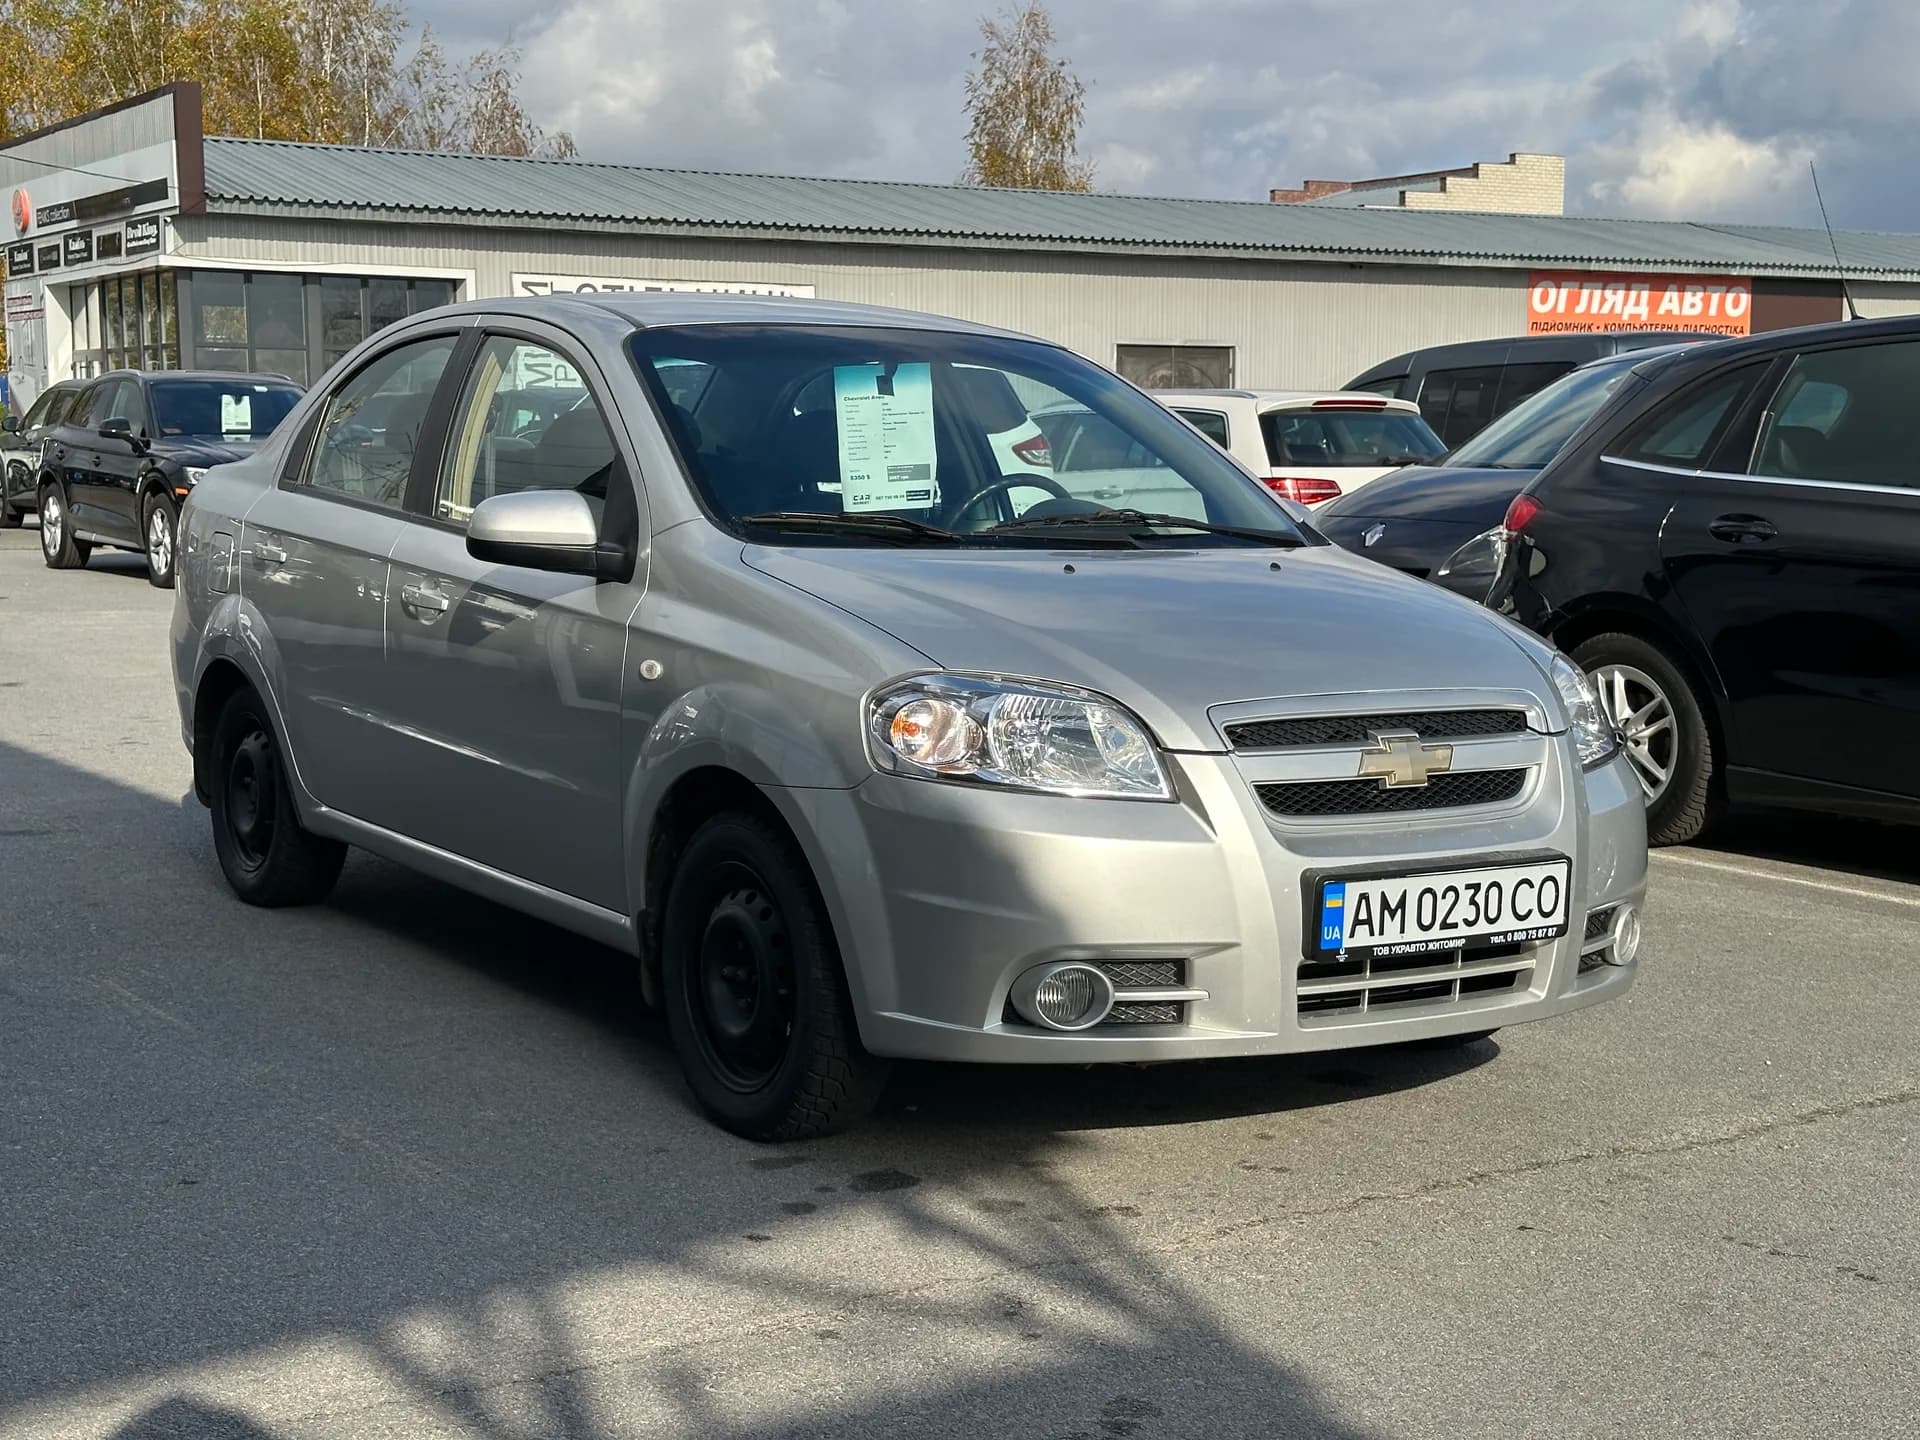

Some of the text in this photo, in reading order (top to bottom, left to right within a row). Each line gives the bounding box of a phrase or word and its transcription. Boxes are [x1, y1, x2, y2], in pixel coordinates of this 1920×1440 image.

[1531, 281, 1748, 321] ОГЛЯД АВТО
[1530, 320, 1594, 333] ПІДЙОМНИК
[1348, 875, 1559, 938] AM 0230 CO
[1324, 926, 1341, 941] UA
[1490, 935, 1505, 944] тел.
[1507, 932, 1512, 941] 0
[1528, 929, 1537, 939] 75
[1373, 939, 1466, 956] ТОВ УКРАВТО ЖИТОМИР
